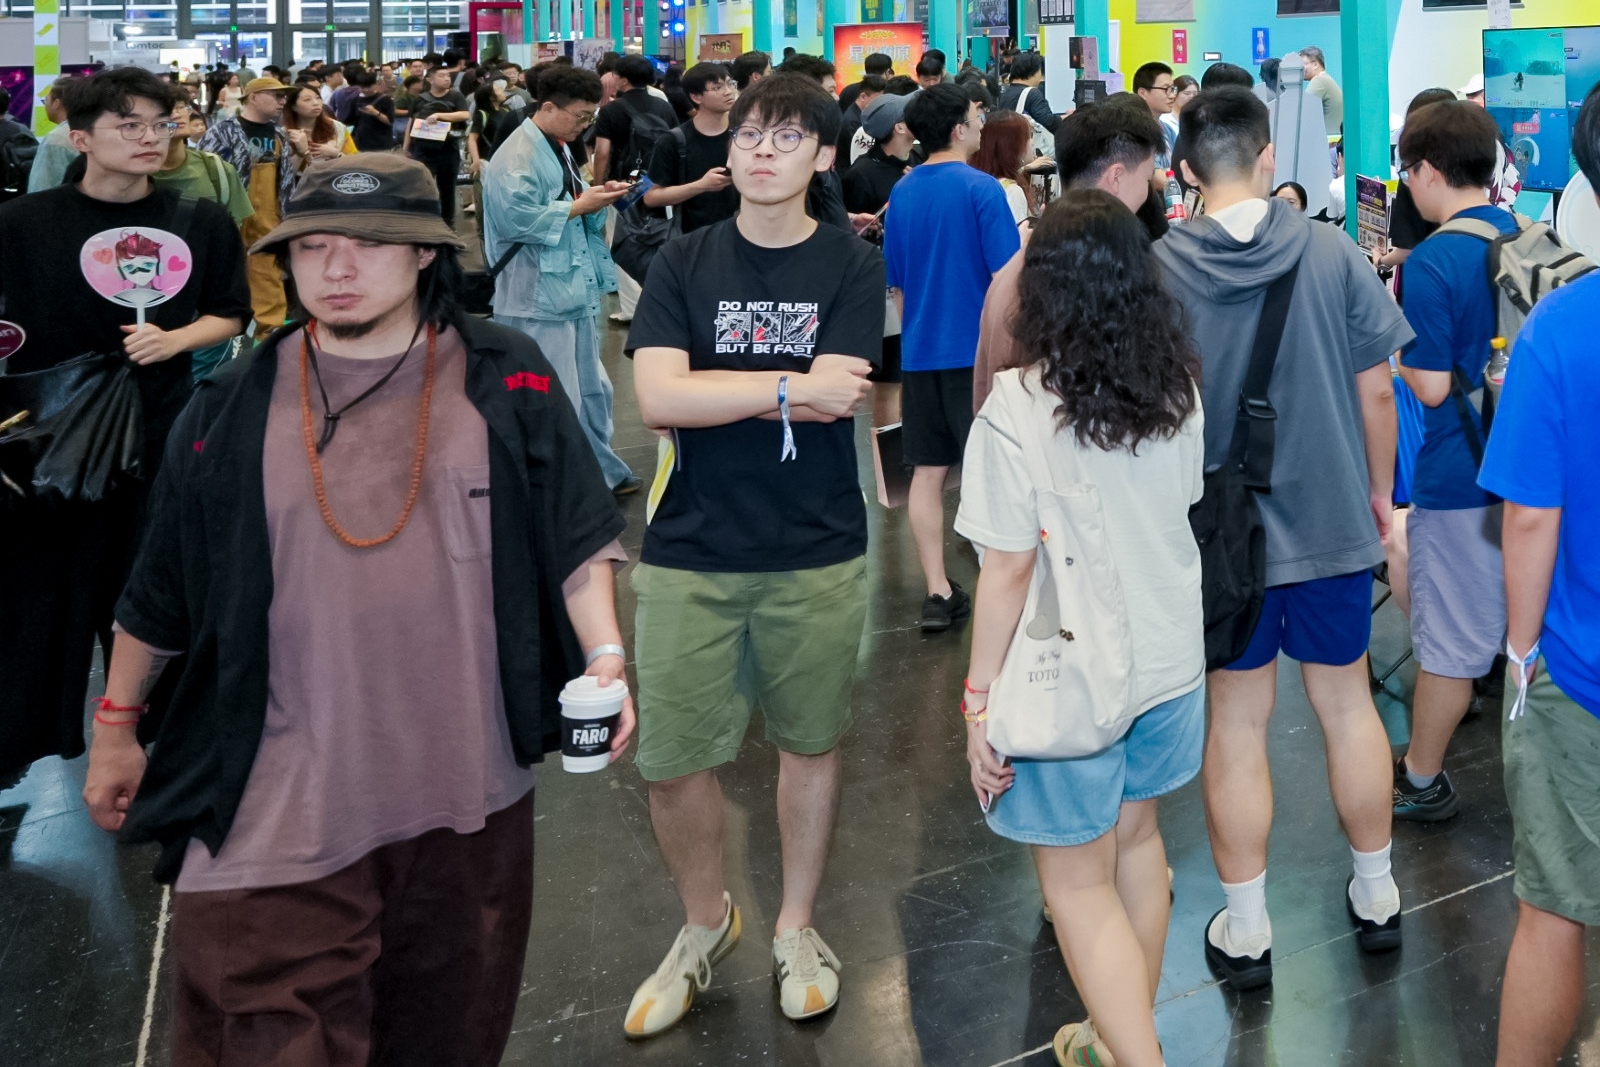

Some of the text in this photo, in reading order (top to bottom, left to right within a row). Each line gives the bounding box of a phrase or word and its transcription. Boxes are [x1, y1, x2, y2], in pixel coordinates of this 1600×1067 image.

[718, 301, 818, 313] DO NOT RUSH
[716, 344, 815, 355] BUT BE FAST
[572, 727, 609, 745] FARO
